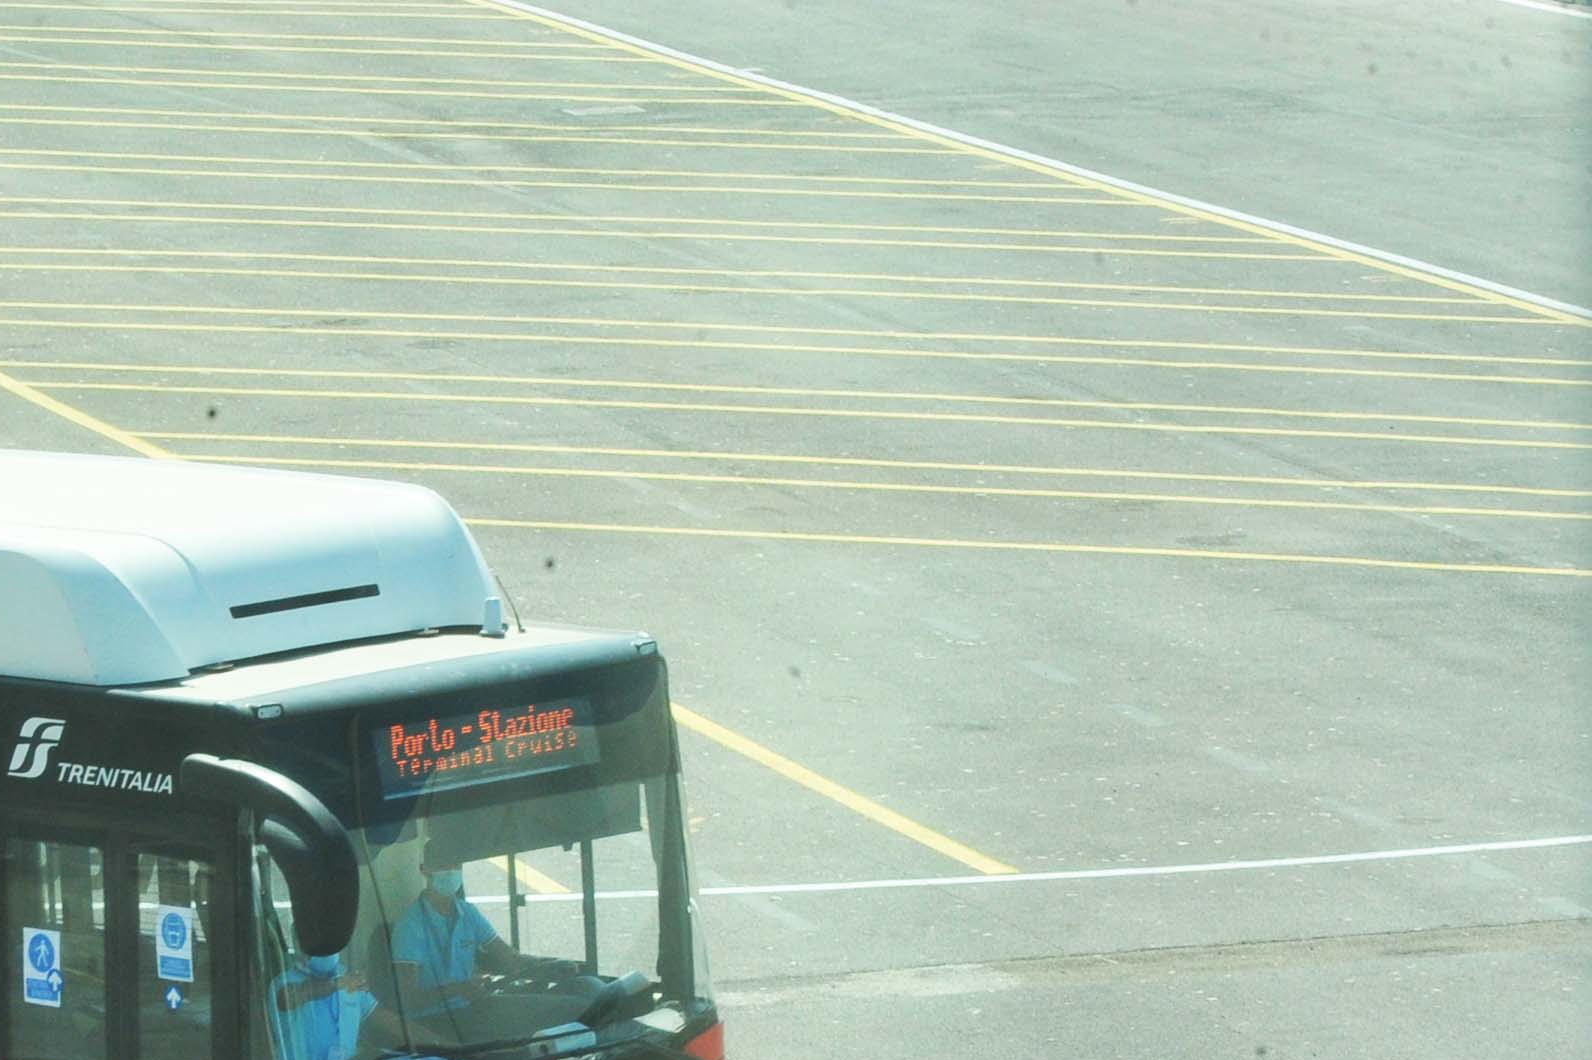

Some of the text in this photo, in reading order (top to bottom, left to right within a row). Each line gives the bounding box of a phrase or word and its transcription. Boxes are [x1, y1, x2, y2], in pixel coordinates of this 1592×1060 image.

[390, 718, 456, 760] Porto
[478, 703, 575, 744] Stazione
[395, 730, 577, 778] Terminal Cruise
[57, 762, 173, 795] TRENITALIA
